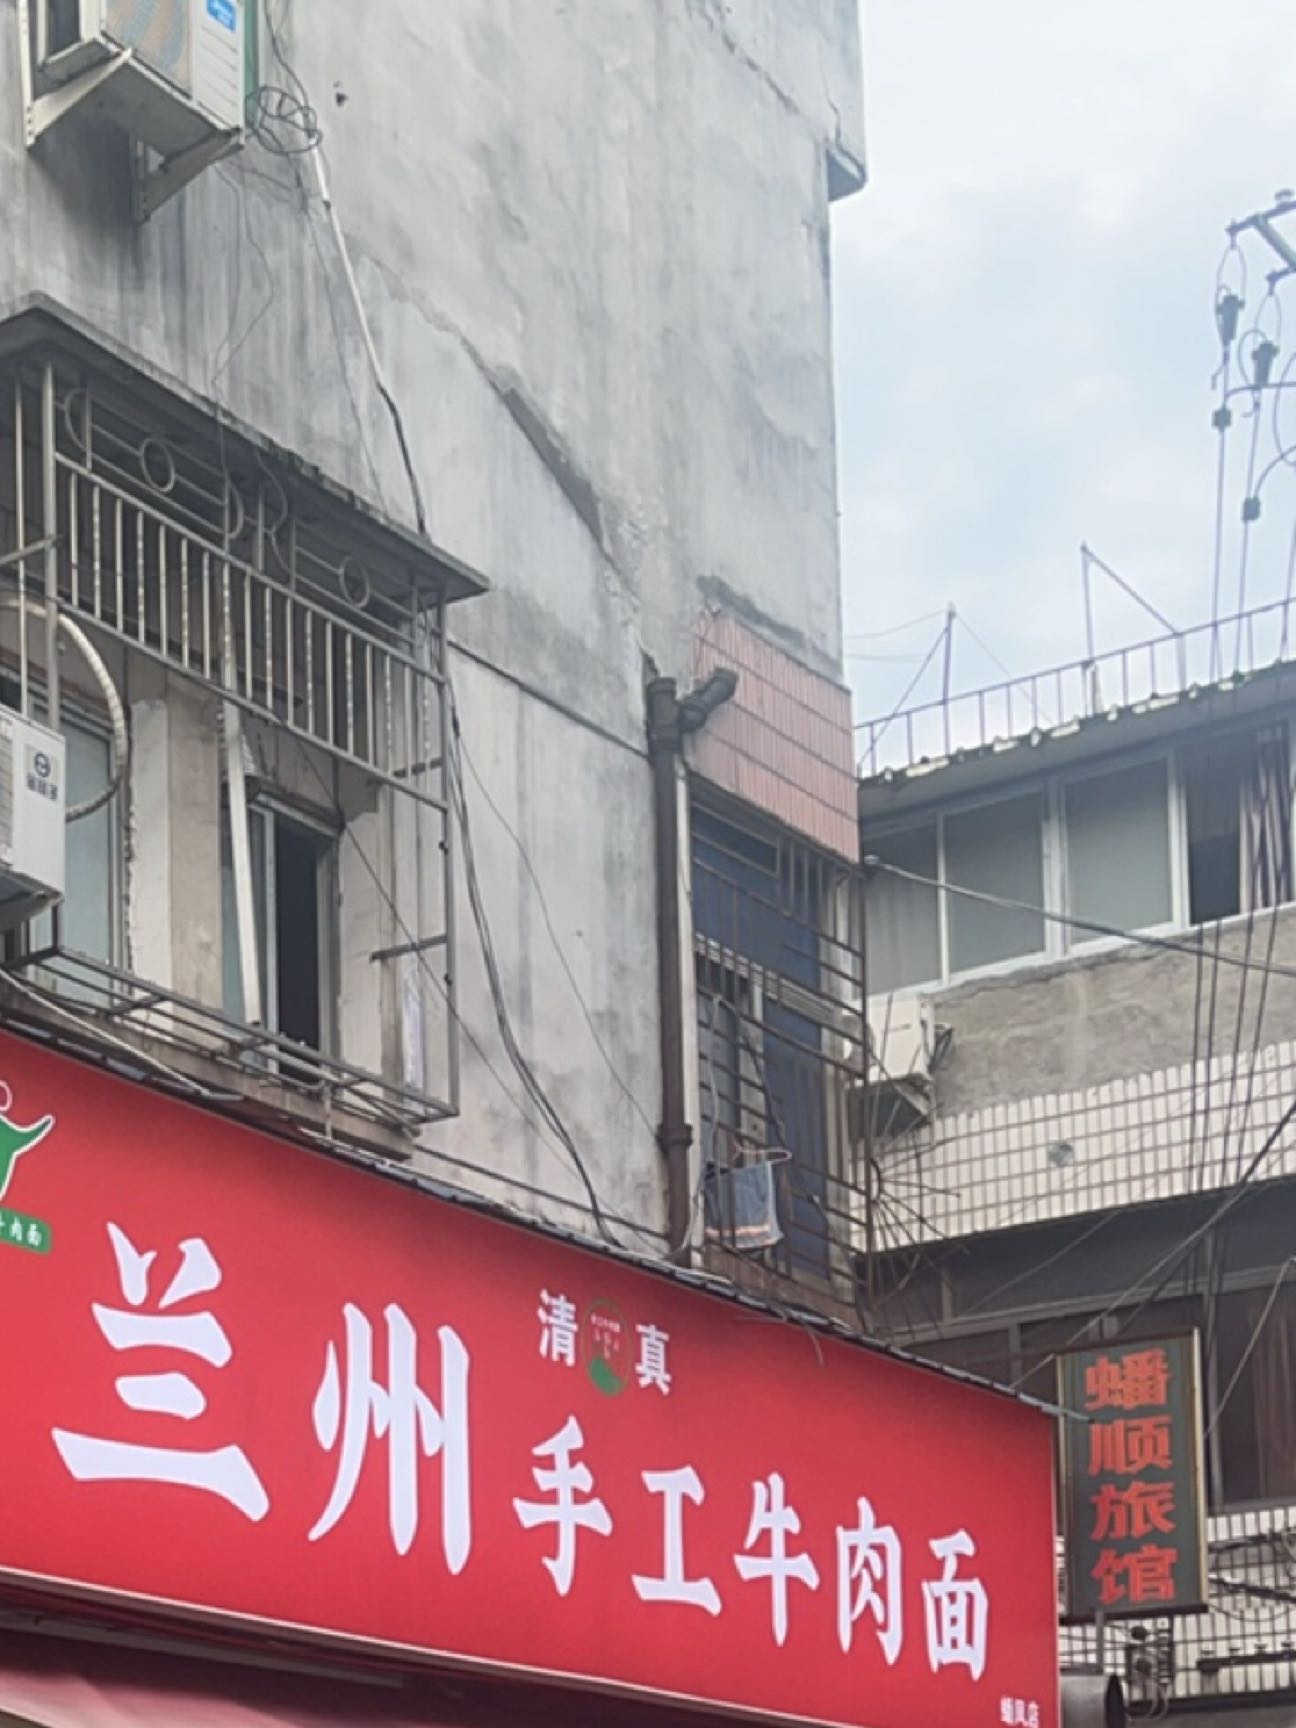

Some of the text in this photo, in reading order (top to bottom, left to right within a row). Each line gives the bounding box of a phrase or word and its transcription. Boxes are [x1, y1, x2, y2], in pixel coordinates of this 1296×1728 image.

[50, 1220, 990, 1682] 兰州 手工牛肉面
[538, 1288, 672, 1396] 清真
[1085, 1348, 1178, 1606] 蟠顺旅馆
